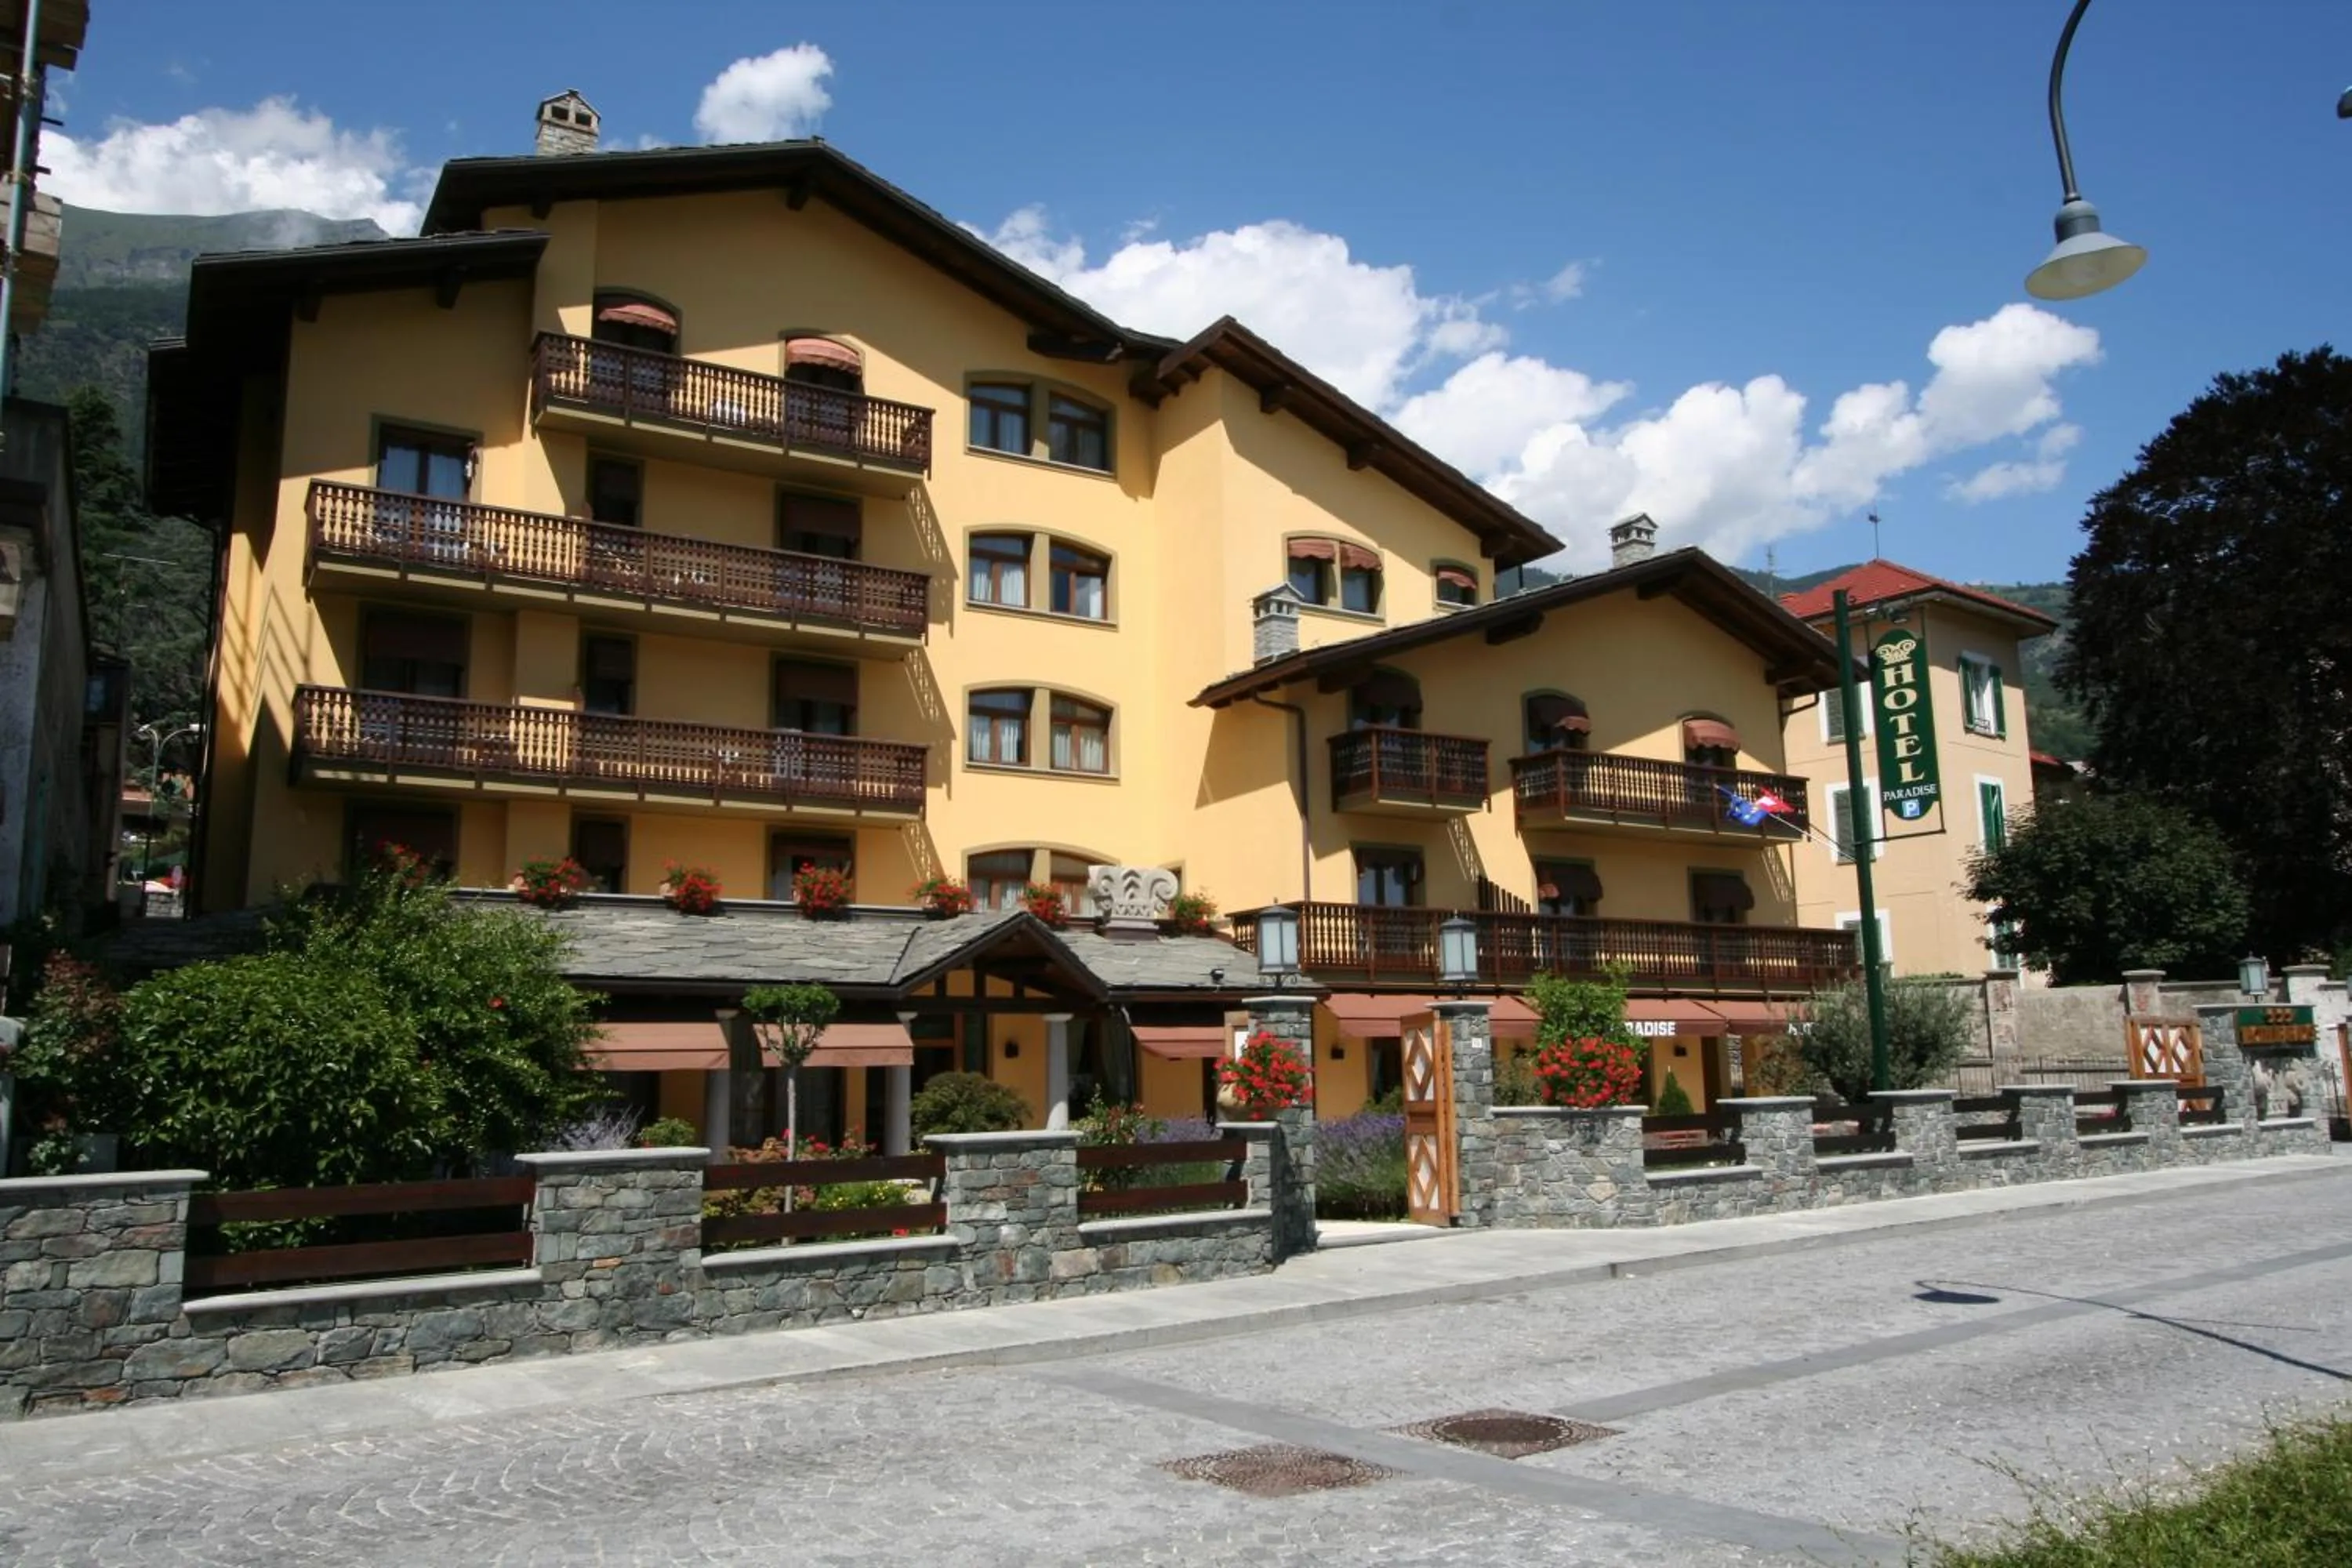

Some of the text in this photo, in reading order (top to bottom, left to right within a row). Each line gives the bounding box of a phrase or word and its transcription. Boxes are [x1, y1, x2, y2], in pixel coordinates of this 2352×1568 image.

[1882, 662, 1925, 782] HOTEL
[1883, 784, 1937, 801] PARADISE
[1905, 801, 1918, 816] P
[1624, 1022, 1676, 1036] RADISE
